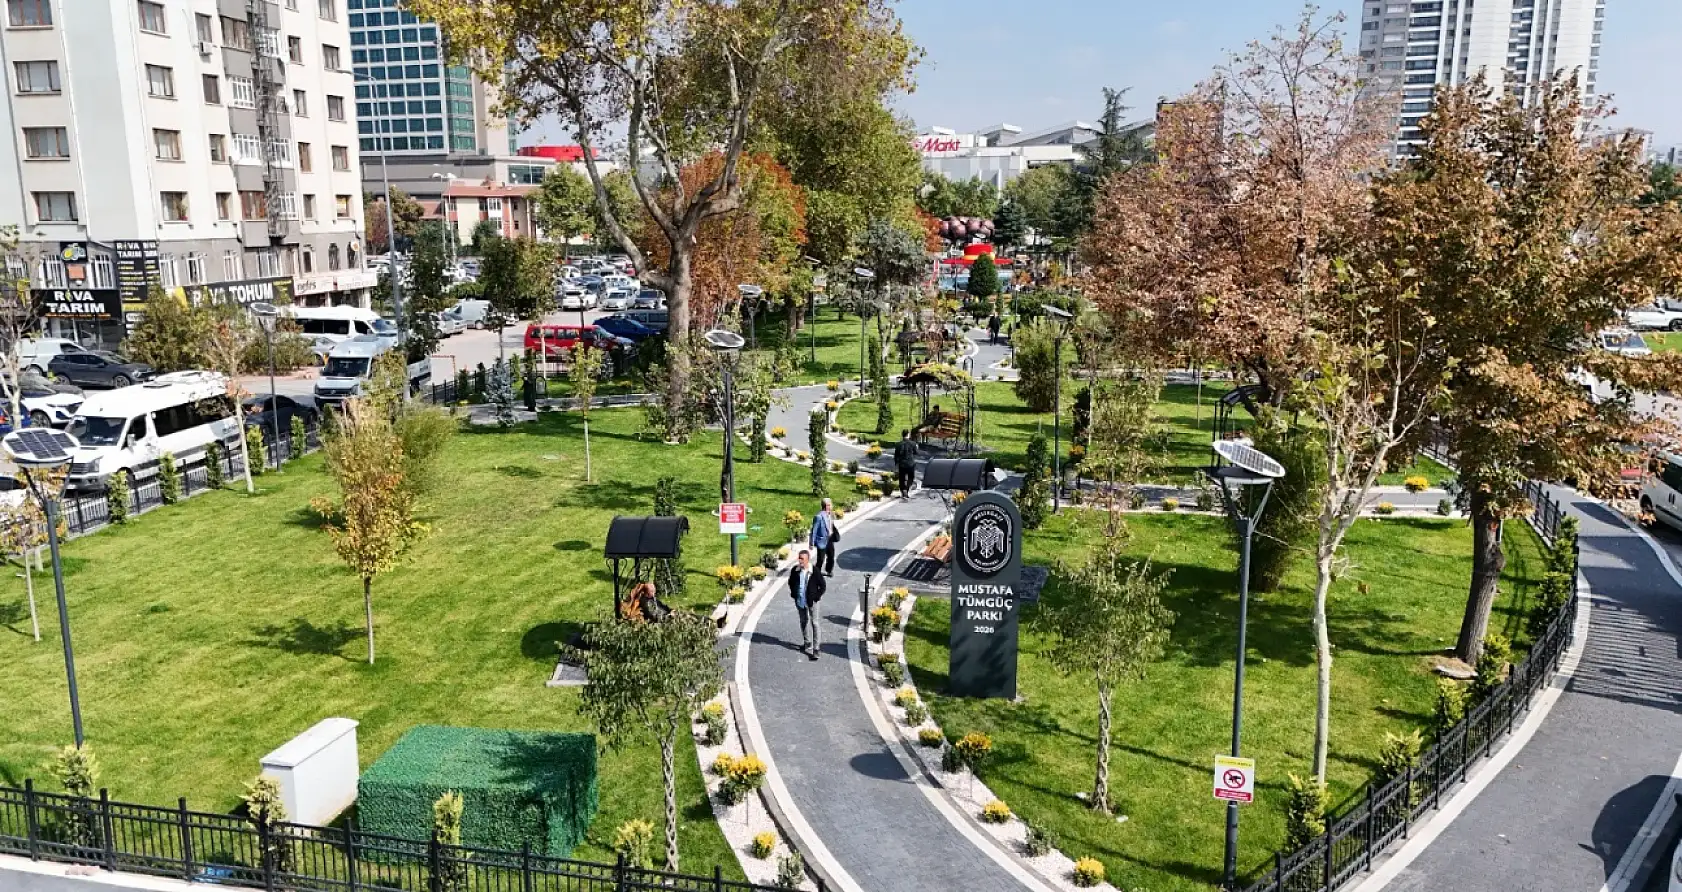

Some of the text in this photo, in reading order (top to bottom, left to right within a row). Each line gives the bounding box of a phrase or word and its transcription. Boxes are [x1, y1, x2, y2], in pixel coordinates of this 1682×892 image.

[921, 137, 961, 152] Markt
[229, 282, 274, 303] TOHUM
[46, 302, 105, 313] TARIM
[958, 584, 1013, 596] MUSTAFA
[957, 594, 1013, 611] TÜMGÜÇ
[967, 610, 1003, 621] PARKI
